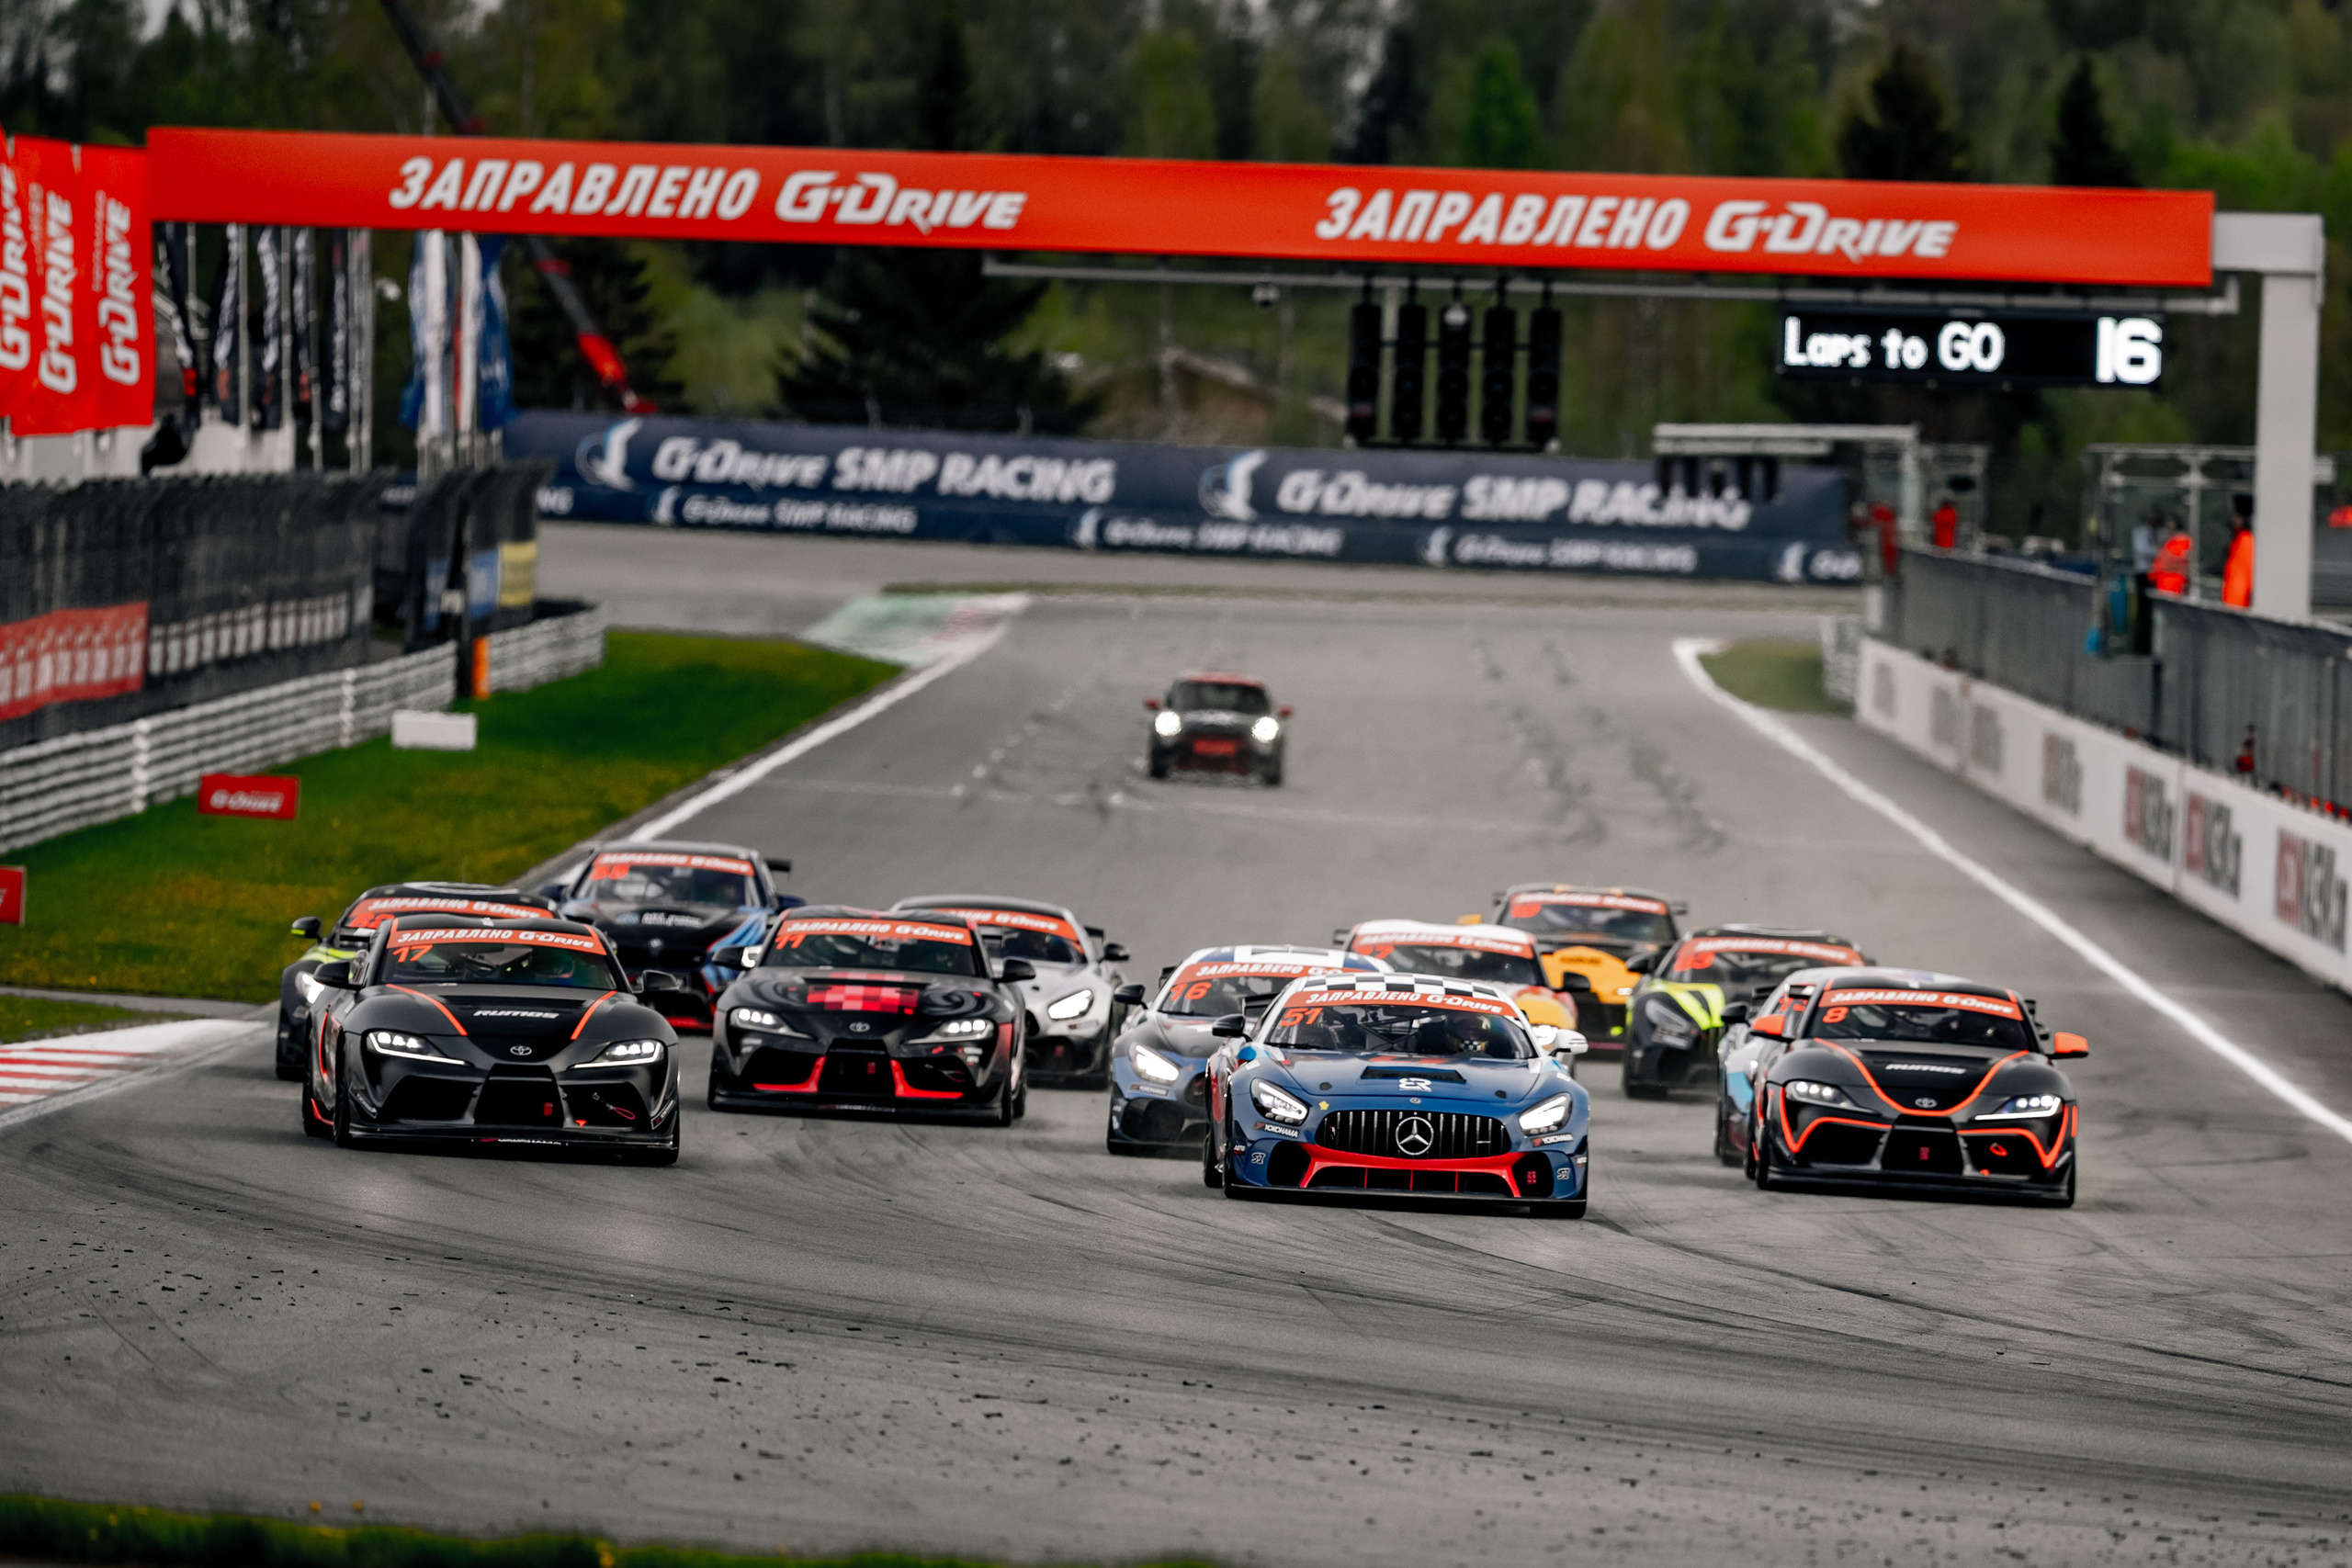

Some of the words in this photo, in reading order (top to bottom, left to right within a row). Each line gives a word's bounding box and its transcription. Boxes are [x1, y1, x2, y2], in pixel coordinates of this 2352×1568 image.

[389, 156, 761, 220] ЗАПРАВЛЕНО
[1315, 186, 1691, 250] ЗАПРАВЛЕНО
[1783, 316, 1871, 368] Laps
[1881, 328, 1928, 370] to
[1938, 321, 2006, 372] GO
[2095, 317, 2163, 384] 16
[831, 446, 940, 491] SMP
[938, 454, 1117, 503] RACING
[1461, 476, 1570, 522] SMP
[398, 929, 514, 943] ЗАПРАВЛЕНО
[787, 920, 891, 934] ЗАПРАВЛЕНО
[392, 944, 434, 964] 17
[1196, 963, 1304, 977] ЗАПРАВЛЕНО
[1170, 982, 1213, 1001] 16
[1306, 991, 1420, 1006] ЗАПРАВЛЕНО
[1830, 989, 1939, 1003] ЗАПРАВЛЕНО
[1280, 1007, 1323, 1028] 51
[1822, 1007, 1849, 1024] 8
[1264, 1123, 1299, 1139] YOKOHAMA
